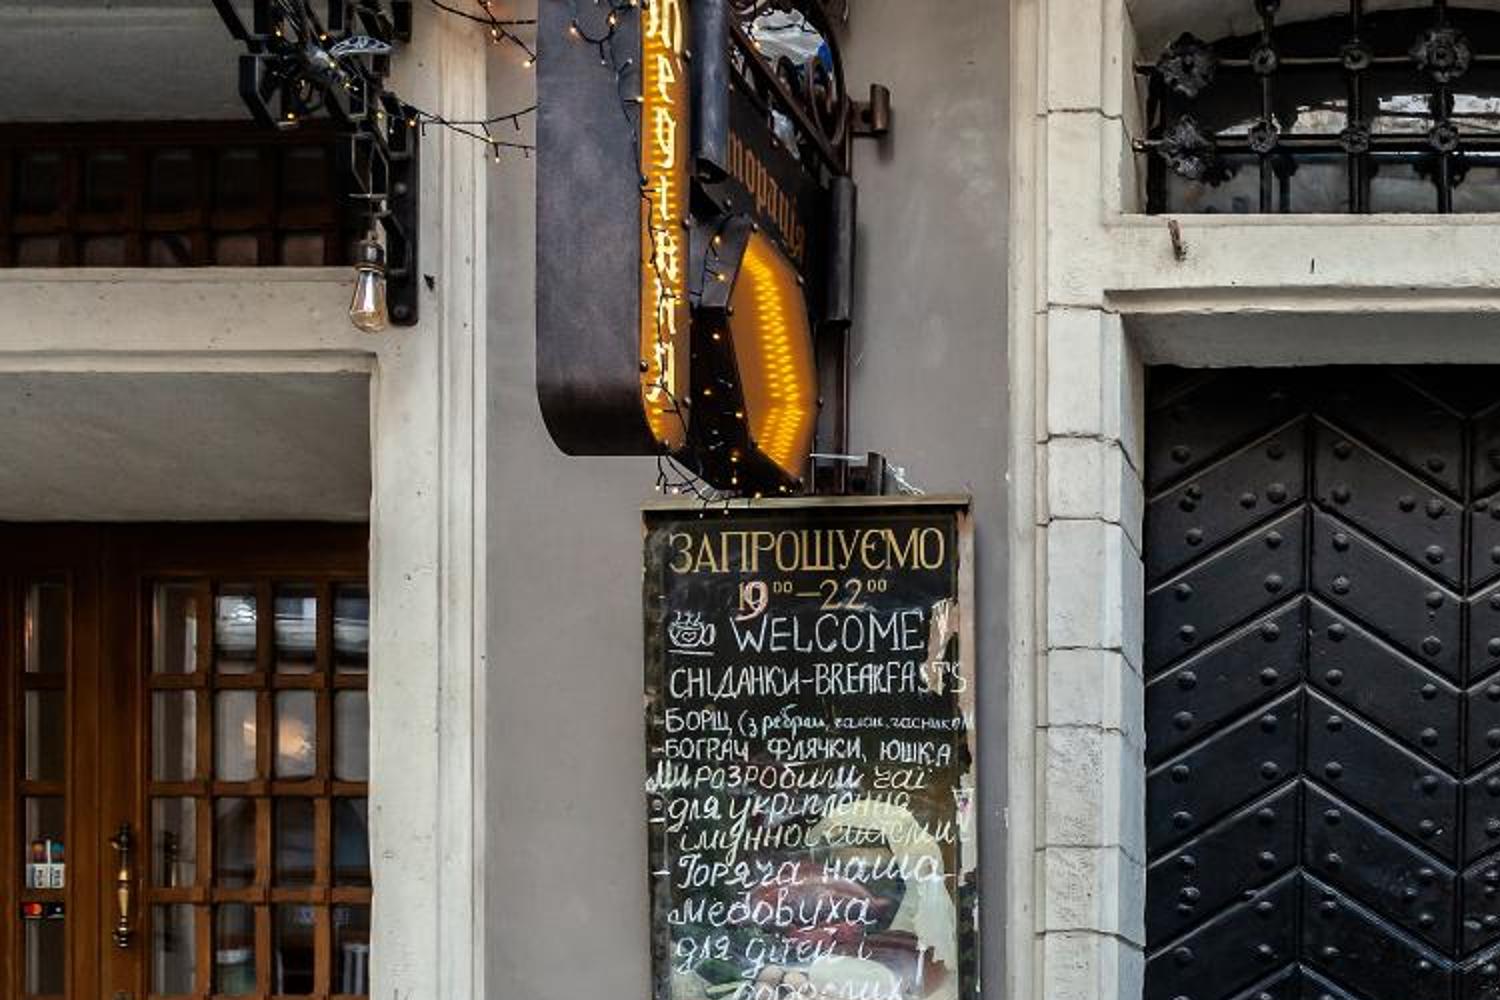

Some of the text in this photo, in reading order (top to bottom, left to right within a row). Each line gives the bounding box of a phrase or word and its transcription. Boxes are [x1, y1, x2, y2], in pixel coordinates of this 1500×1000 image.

[668, 527, 945, 573] ЗАПРОШУЄМО
[730, 608, 925, 653] WELCOME
[879, 738, 951, 767] ЮШКА
